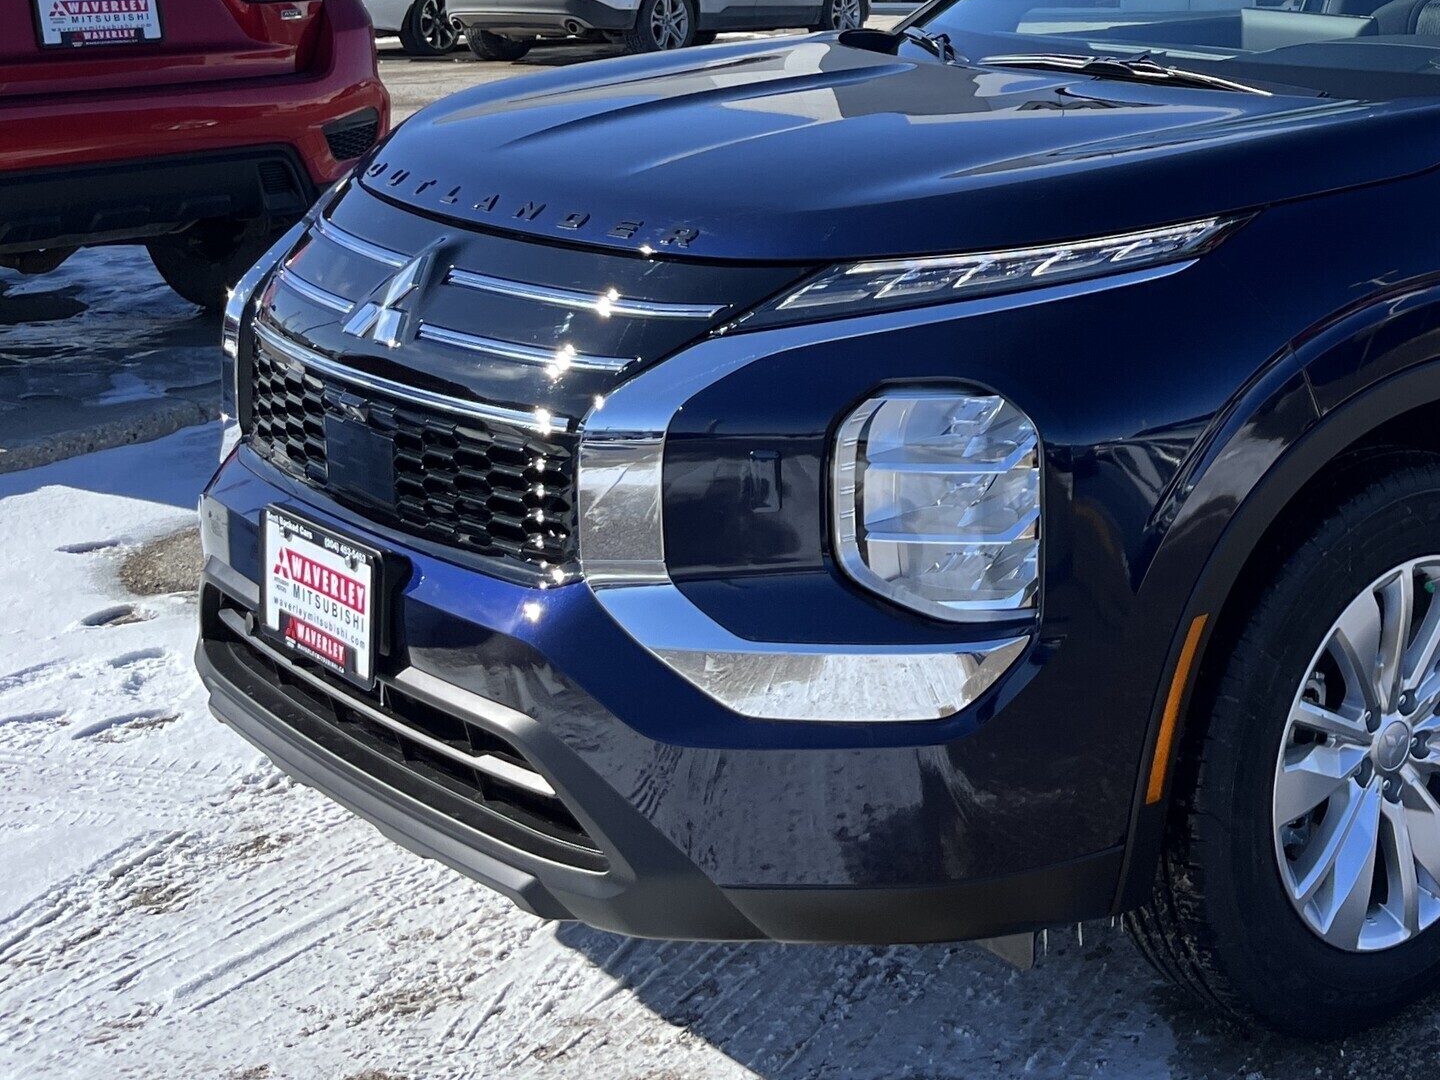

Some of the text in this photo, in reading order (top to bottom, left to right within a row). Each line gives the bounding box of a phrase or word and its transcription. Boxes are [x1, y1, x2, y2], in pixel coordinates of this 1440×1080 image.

[67, 0, 146, 14] WAVERLEY
[71, 13, 150, 24] MITSUBISHI
[84, 29, 135, 40] WAVERLEY
[366, 162, 700, 248] OUTLANDER
[291, 554, 365, 610] WAVERLEY
[273, 596, 366, 650] waverleymitsubishi.com
[293, 583, 365, 632] MITSUBISHI
[296, 622, 345, 662] WAVERLEY
